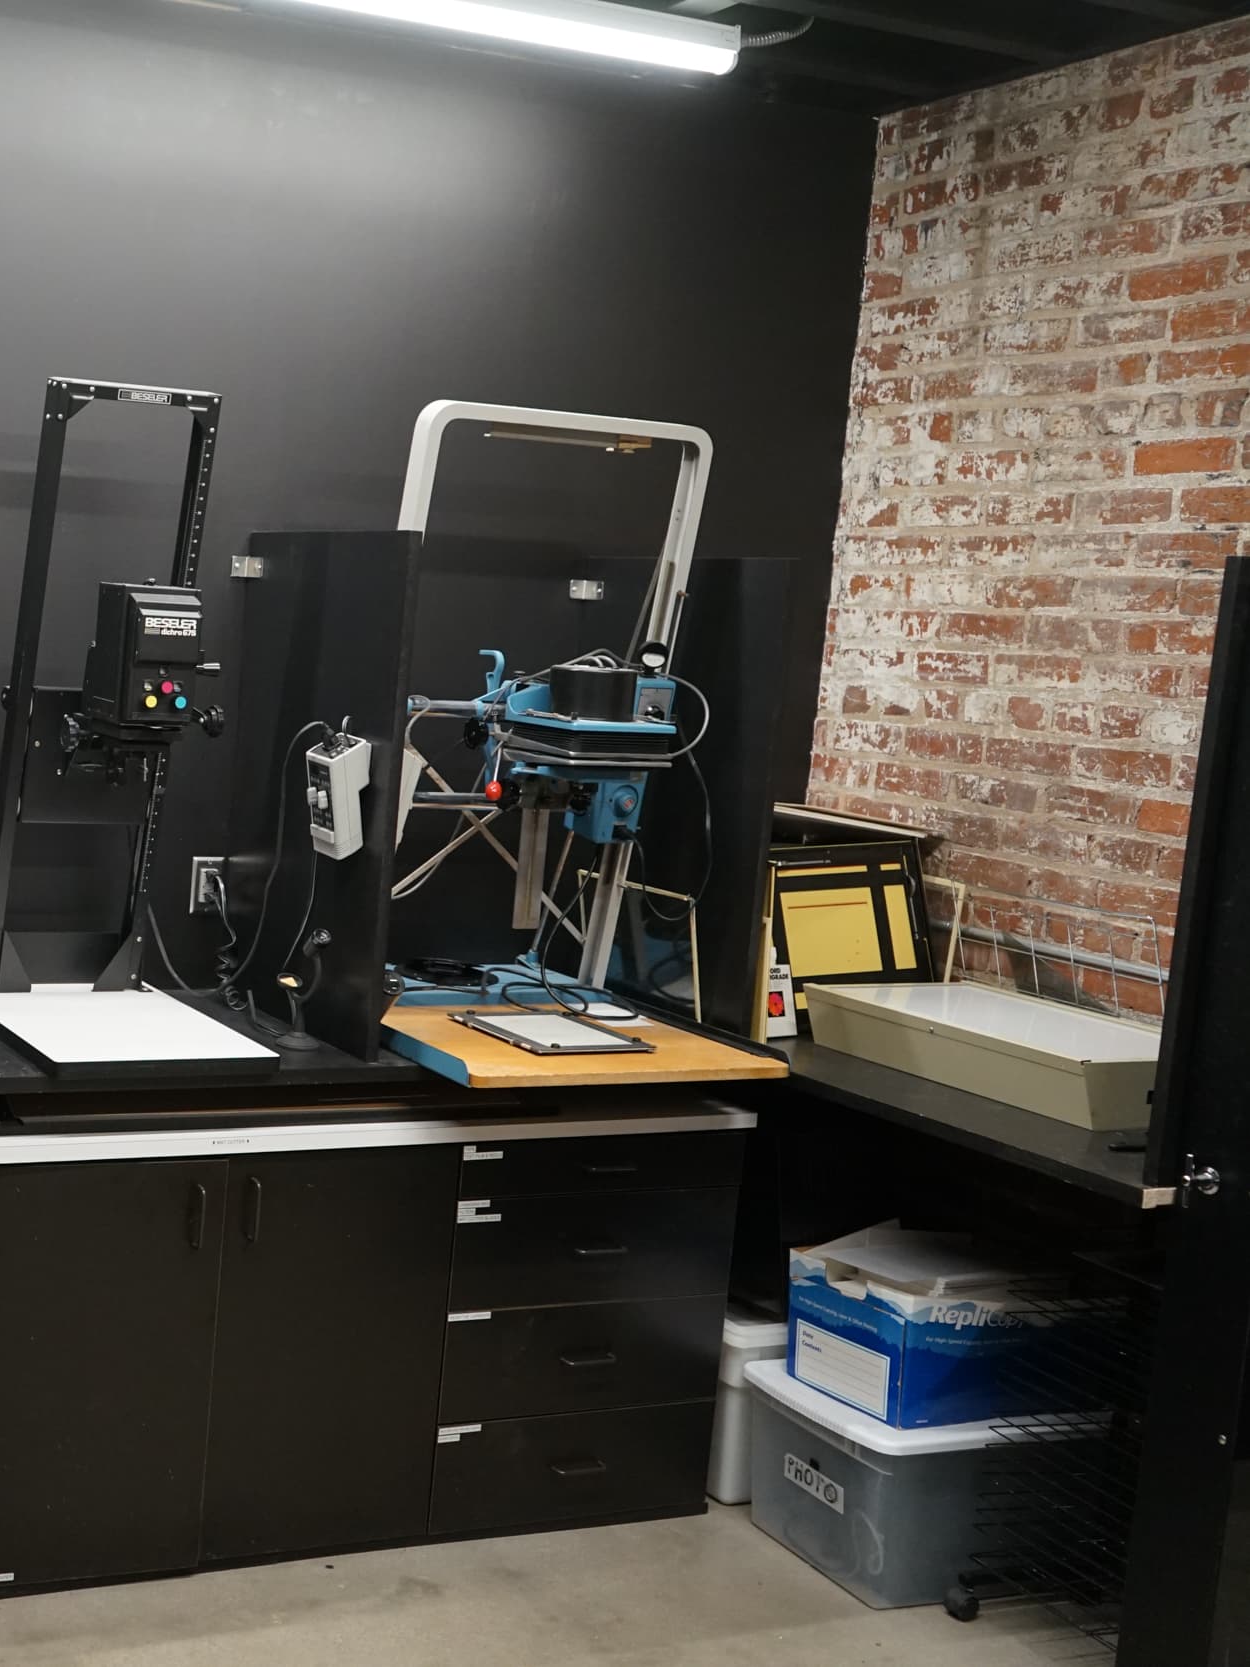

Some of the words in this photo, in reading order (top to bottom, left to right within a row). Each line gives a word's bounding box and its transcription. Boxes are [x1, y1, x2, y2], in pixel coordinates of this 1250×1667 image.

[131, 391, 169, 404] BESELER
[144, 617, 197, 630] BESELER
[160, 628, 183, 637] dichro
[787, 1456, 839, 1504] PHOTO
